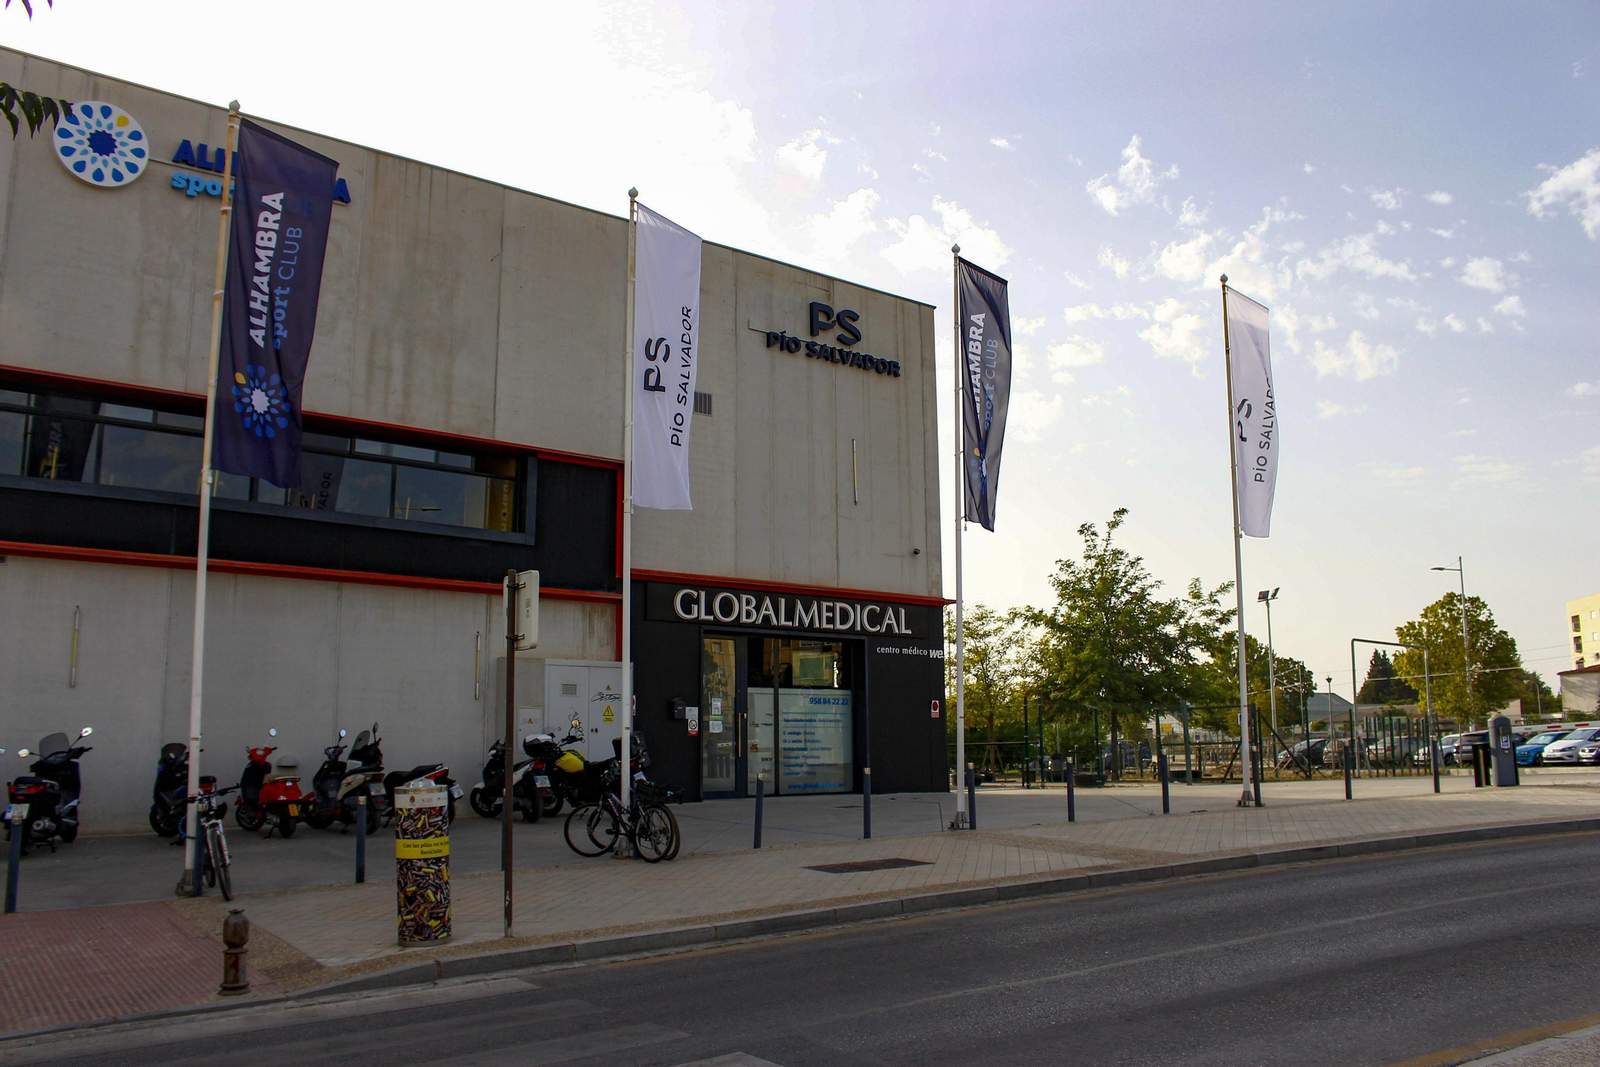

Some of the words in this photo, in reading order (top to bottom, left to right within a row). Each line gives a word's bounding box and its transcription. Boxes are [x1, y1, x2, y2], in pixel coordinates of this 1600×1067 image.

[249, 191, 284, 349] ALHAMBRA
[277, 226, 302, 280] CLUB
[273, 285, 291, 350] sport
[809, 301, 862, 346] PS
[643, 337, 671, 393] PS
[676, 305, 692, 407] SALVADOR
[805, 340, 901, 378] SALVADOR
[985, 338, 999, 380] CLUB
[673, 589, 912, 635] GLOBALMEDICAL
[876, 646, 900, 654] centro
[902, 646, 928, 656] médico
[809, 697, 821, 705] 958
[822, 697, 831, 705] 84
[841, 698, 849, 706] 22
